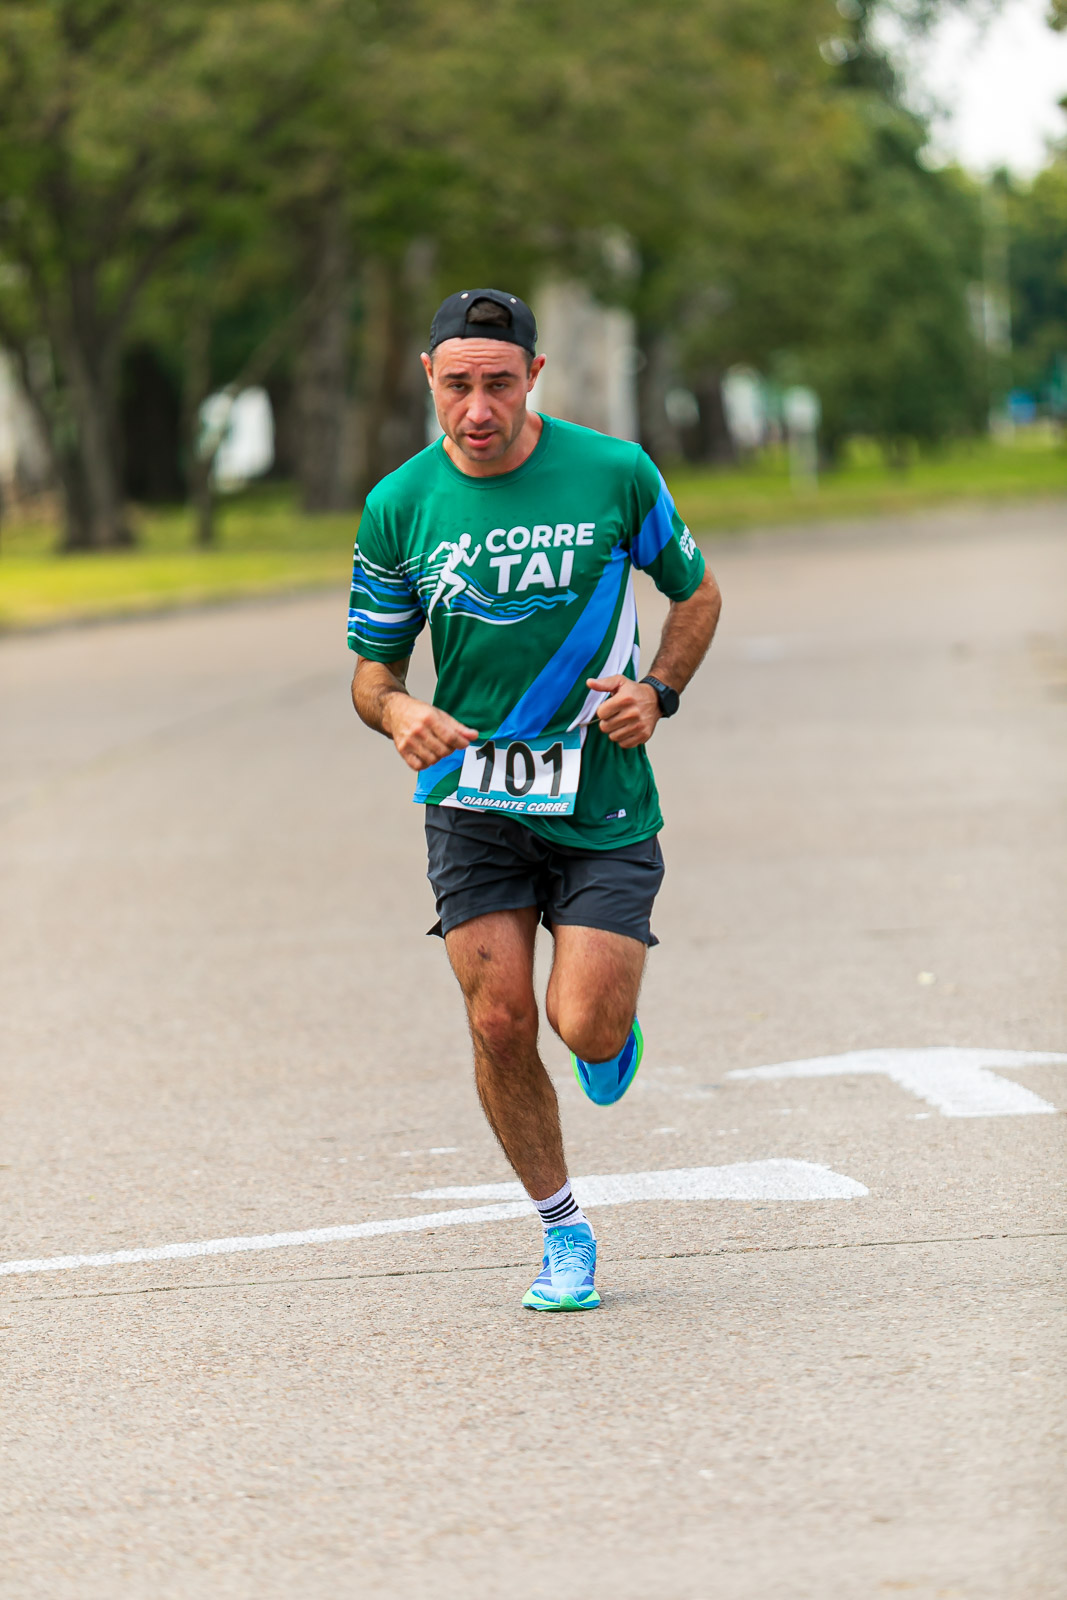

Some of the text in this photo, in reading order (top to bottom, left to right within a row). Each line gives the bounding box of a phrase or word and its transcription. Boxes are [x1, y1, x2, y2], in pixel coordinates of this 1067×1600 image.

[485, 523, 595, 553] CORRE
[489, 550, 575, 594] TAI
[475, 739, 564, 798] 101
[461, 795, 570, 812] DIAMANTE CORRE
